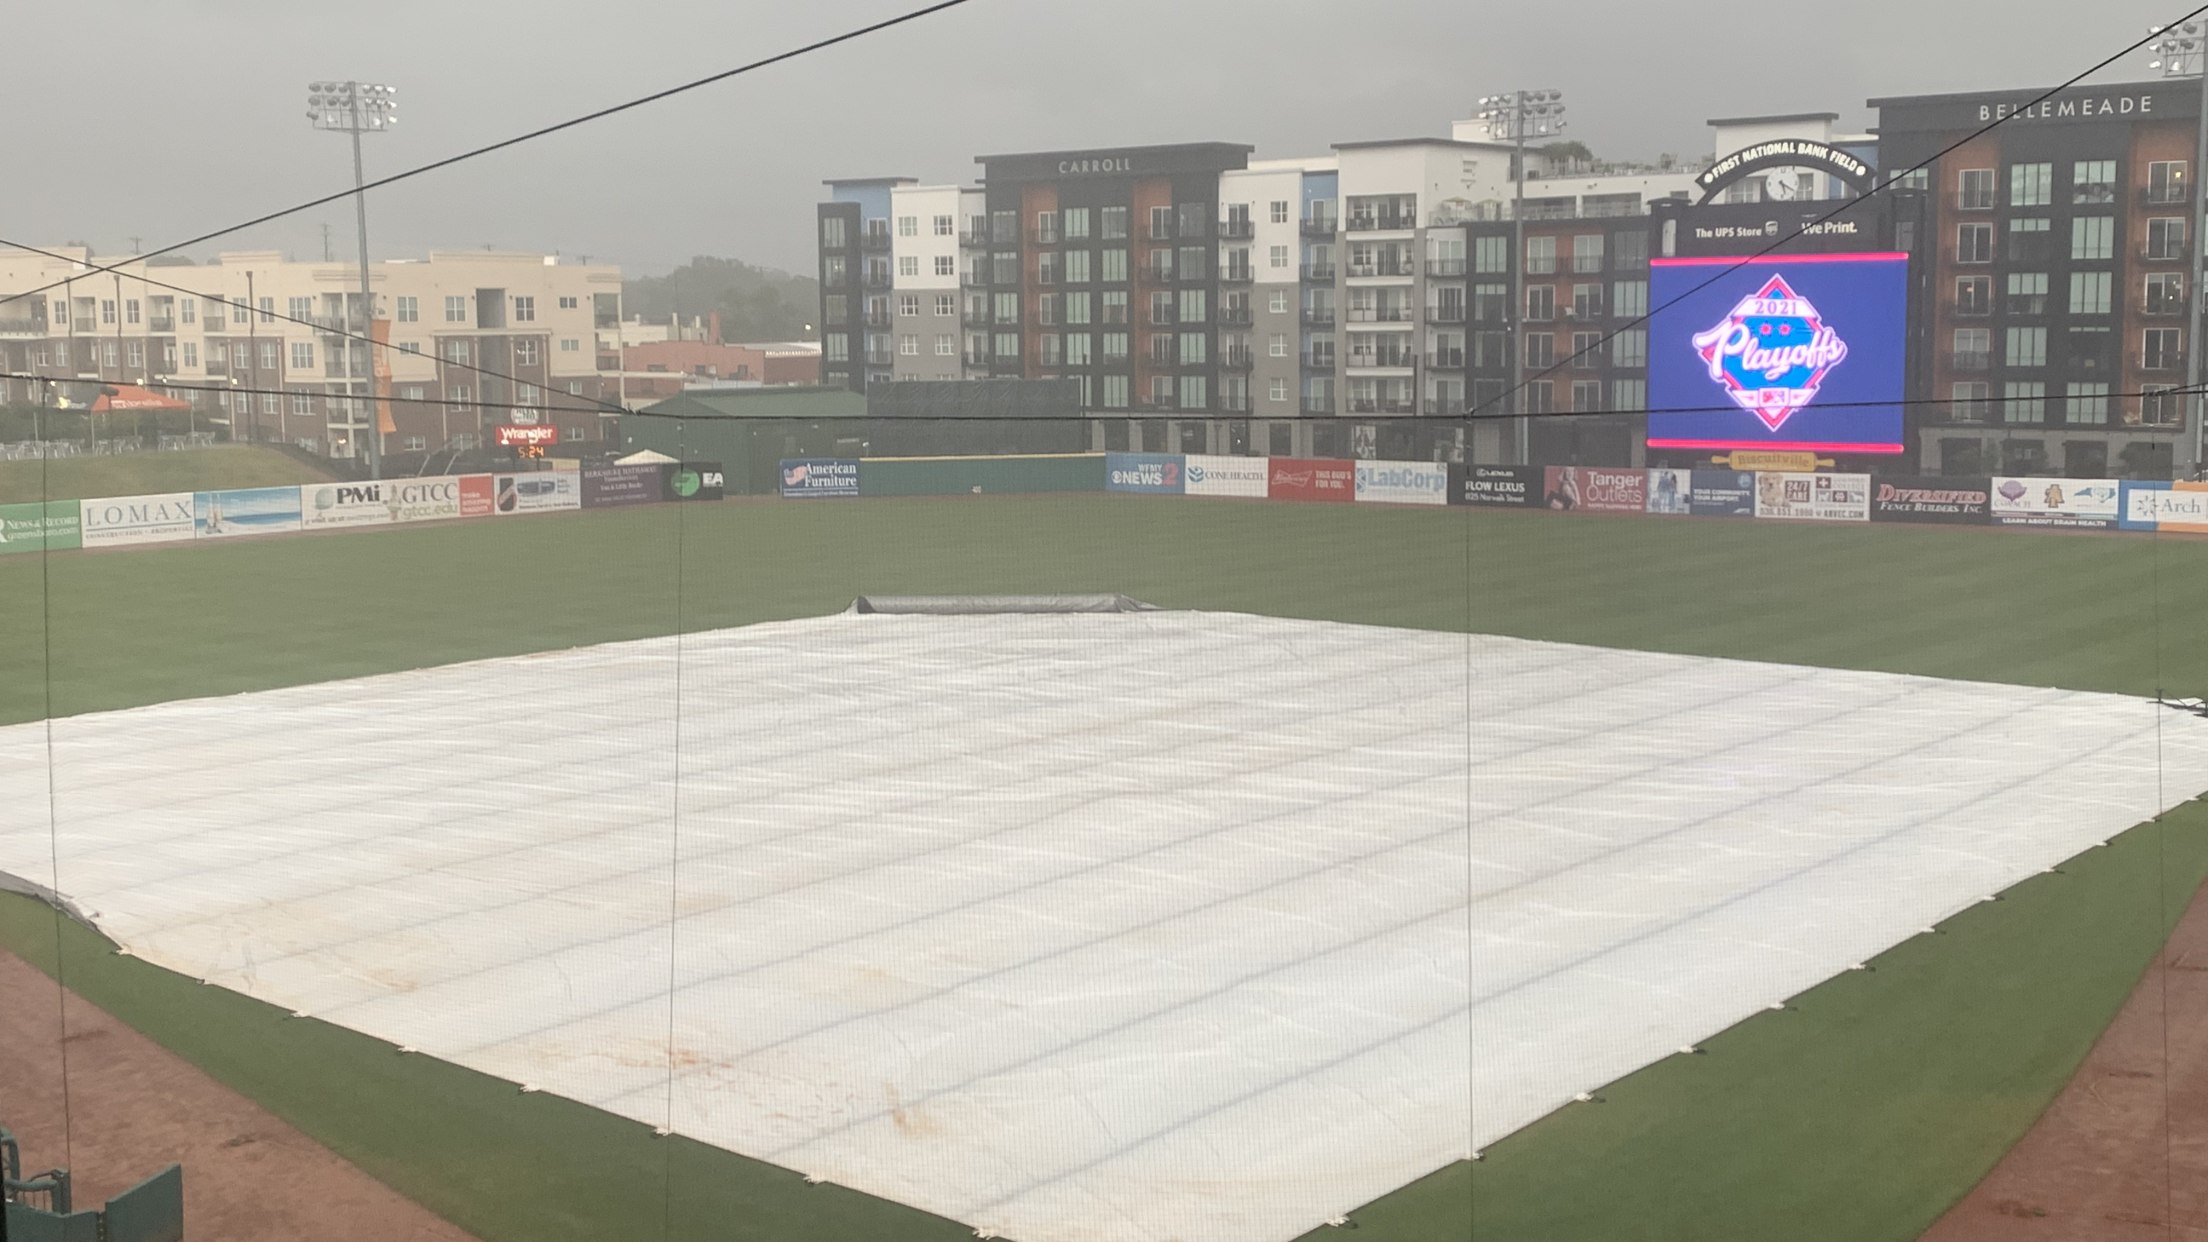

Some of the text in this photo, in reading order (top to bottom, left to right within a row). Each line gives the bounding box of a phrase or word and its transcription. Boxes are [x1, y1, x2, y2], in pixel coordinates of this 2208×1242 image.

[1979, 95, 2152, 121] BELLEMEADE
[1057, 158, 1131, 174] CARROLL
[1711, 142, 1859, 179] FIRST NATIONAL BANK FIELD
[1695, 226, 1762, 238] The UPS Store
[1801, 220, 1857, 235] We Print.
[1755, 301, 1797, 314] 2021
[1695, 320, 1843, 379] Playoffs
[500, 427, 553, 444] Wrangler
[518, 446, 545, 458] 5:24
[806, 461, 857, 474] American
[1122, 462, 1180, 487] NEWS 2
[1138, 463, 1163, 474] WFMY
[1315, 470, 1331, 479] THIS
[804, 474, 857, 488] Furniture
[1205, 472, 1228, 482] CONE
[1315, 479, 1328, 489] FOR
[1367, 467, 1446, 491] LabCorp
[1587, 471, 1642, 490] Tanger
[402, 482, 458, 504] GTCC
[1465, 481, 1525, 493] FLOW LEXUS
[1586, 485, 1642, 503] Outlets
[1786, 482, 1808, 491] 24/7
[337, 485, 380, 505] PMi
[402, 501, 458, 518] gtcc.edu
[2162, 498, 2201, 513] Arch
[85, 501, 192, 526] LOMAX
